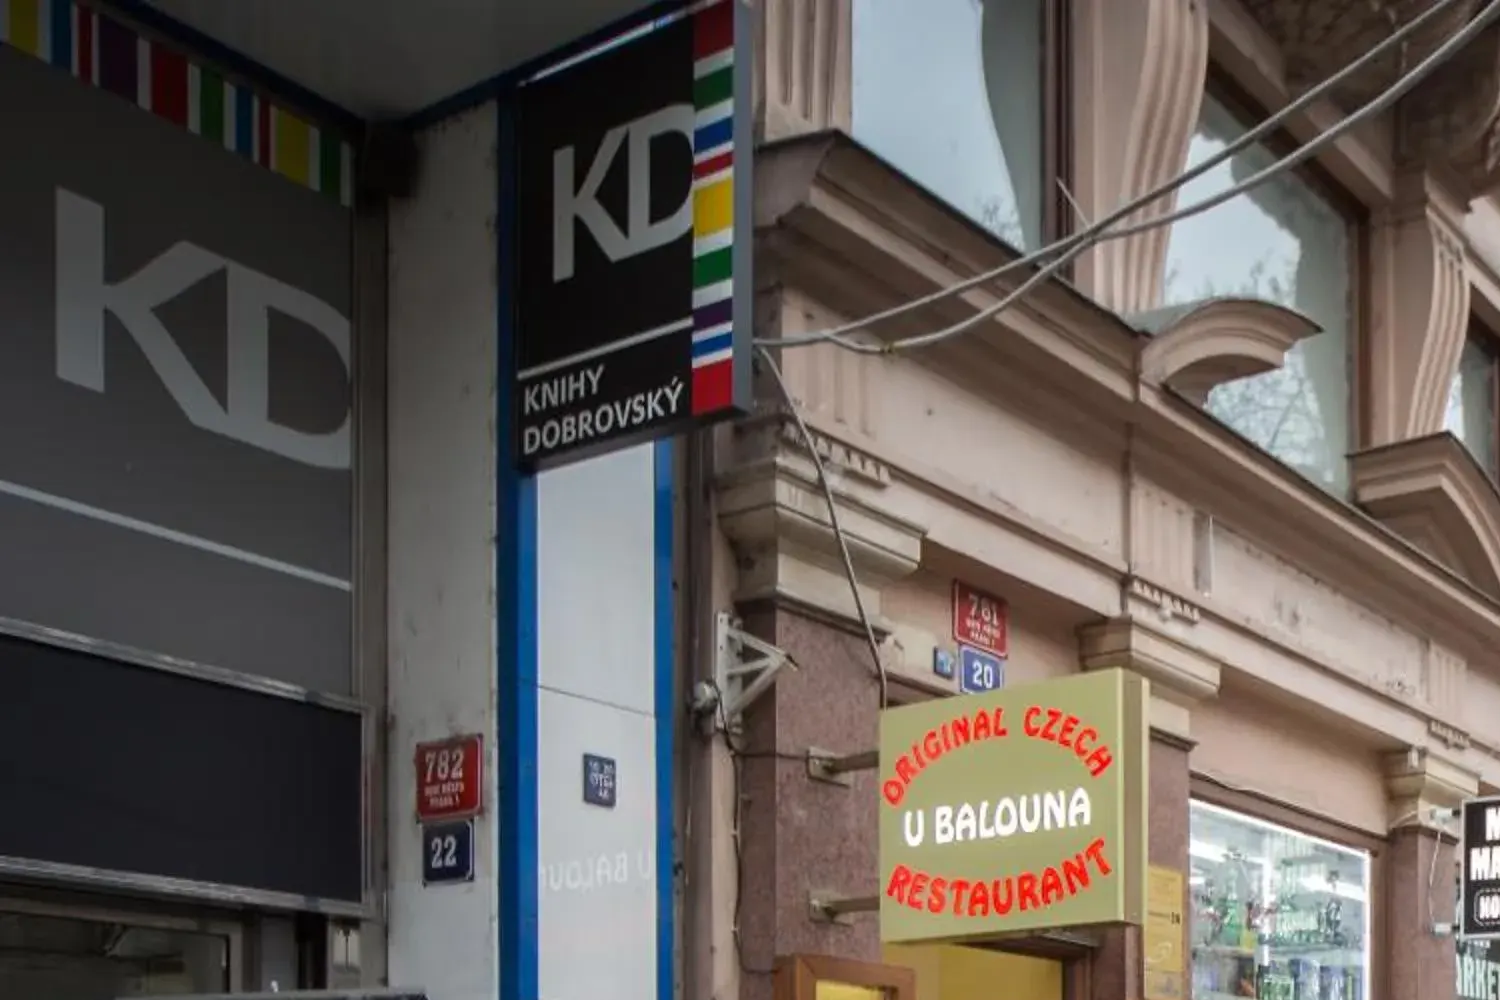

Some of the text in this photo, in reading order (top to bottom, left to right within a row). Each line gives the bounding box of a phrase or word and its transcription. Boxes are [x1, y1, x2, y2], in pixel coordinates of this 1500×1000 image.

[553, 103, 694, 283] KD
[56, 185, 351, 469] KD
[523, 364, 604, 415] KNIHY
[523, 376, 684, 455] DOBROVSKÝ
[972, 659, 993, 689] 20
[425, 748, 464, 783] 782
[882, 705, 1113, 808] ORIGINAL CZECH
[431, 834, 457, 869] 22
[904, 786, 1092, 847] U BALOUNA
[886, 837, 1112, 918] RESTAURANT
